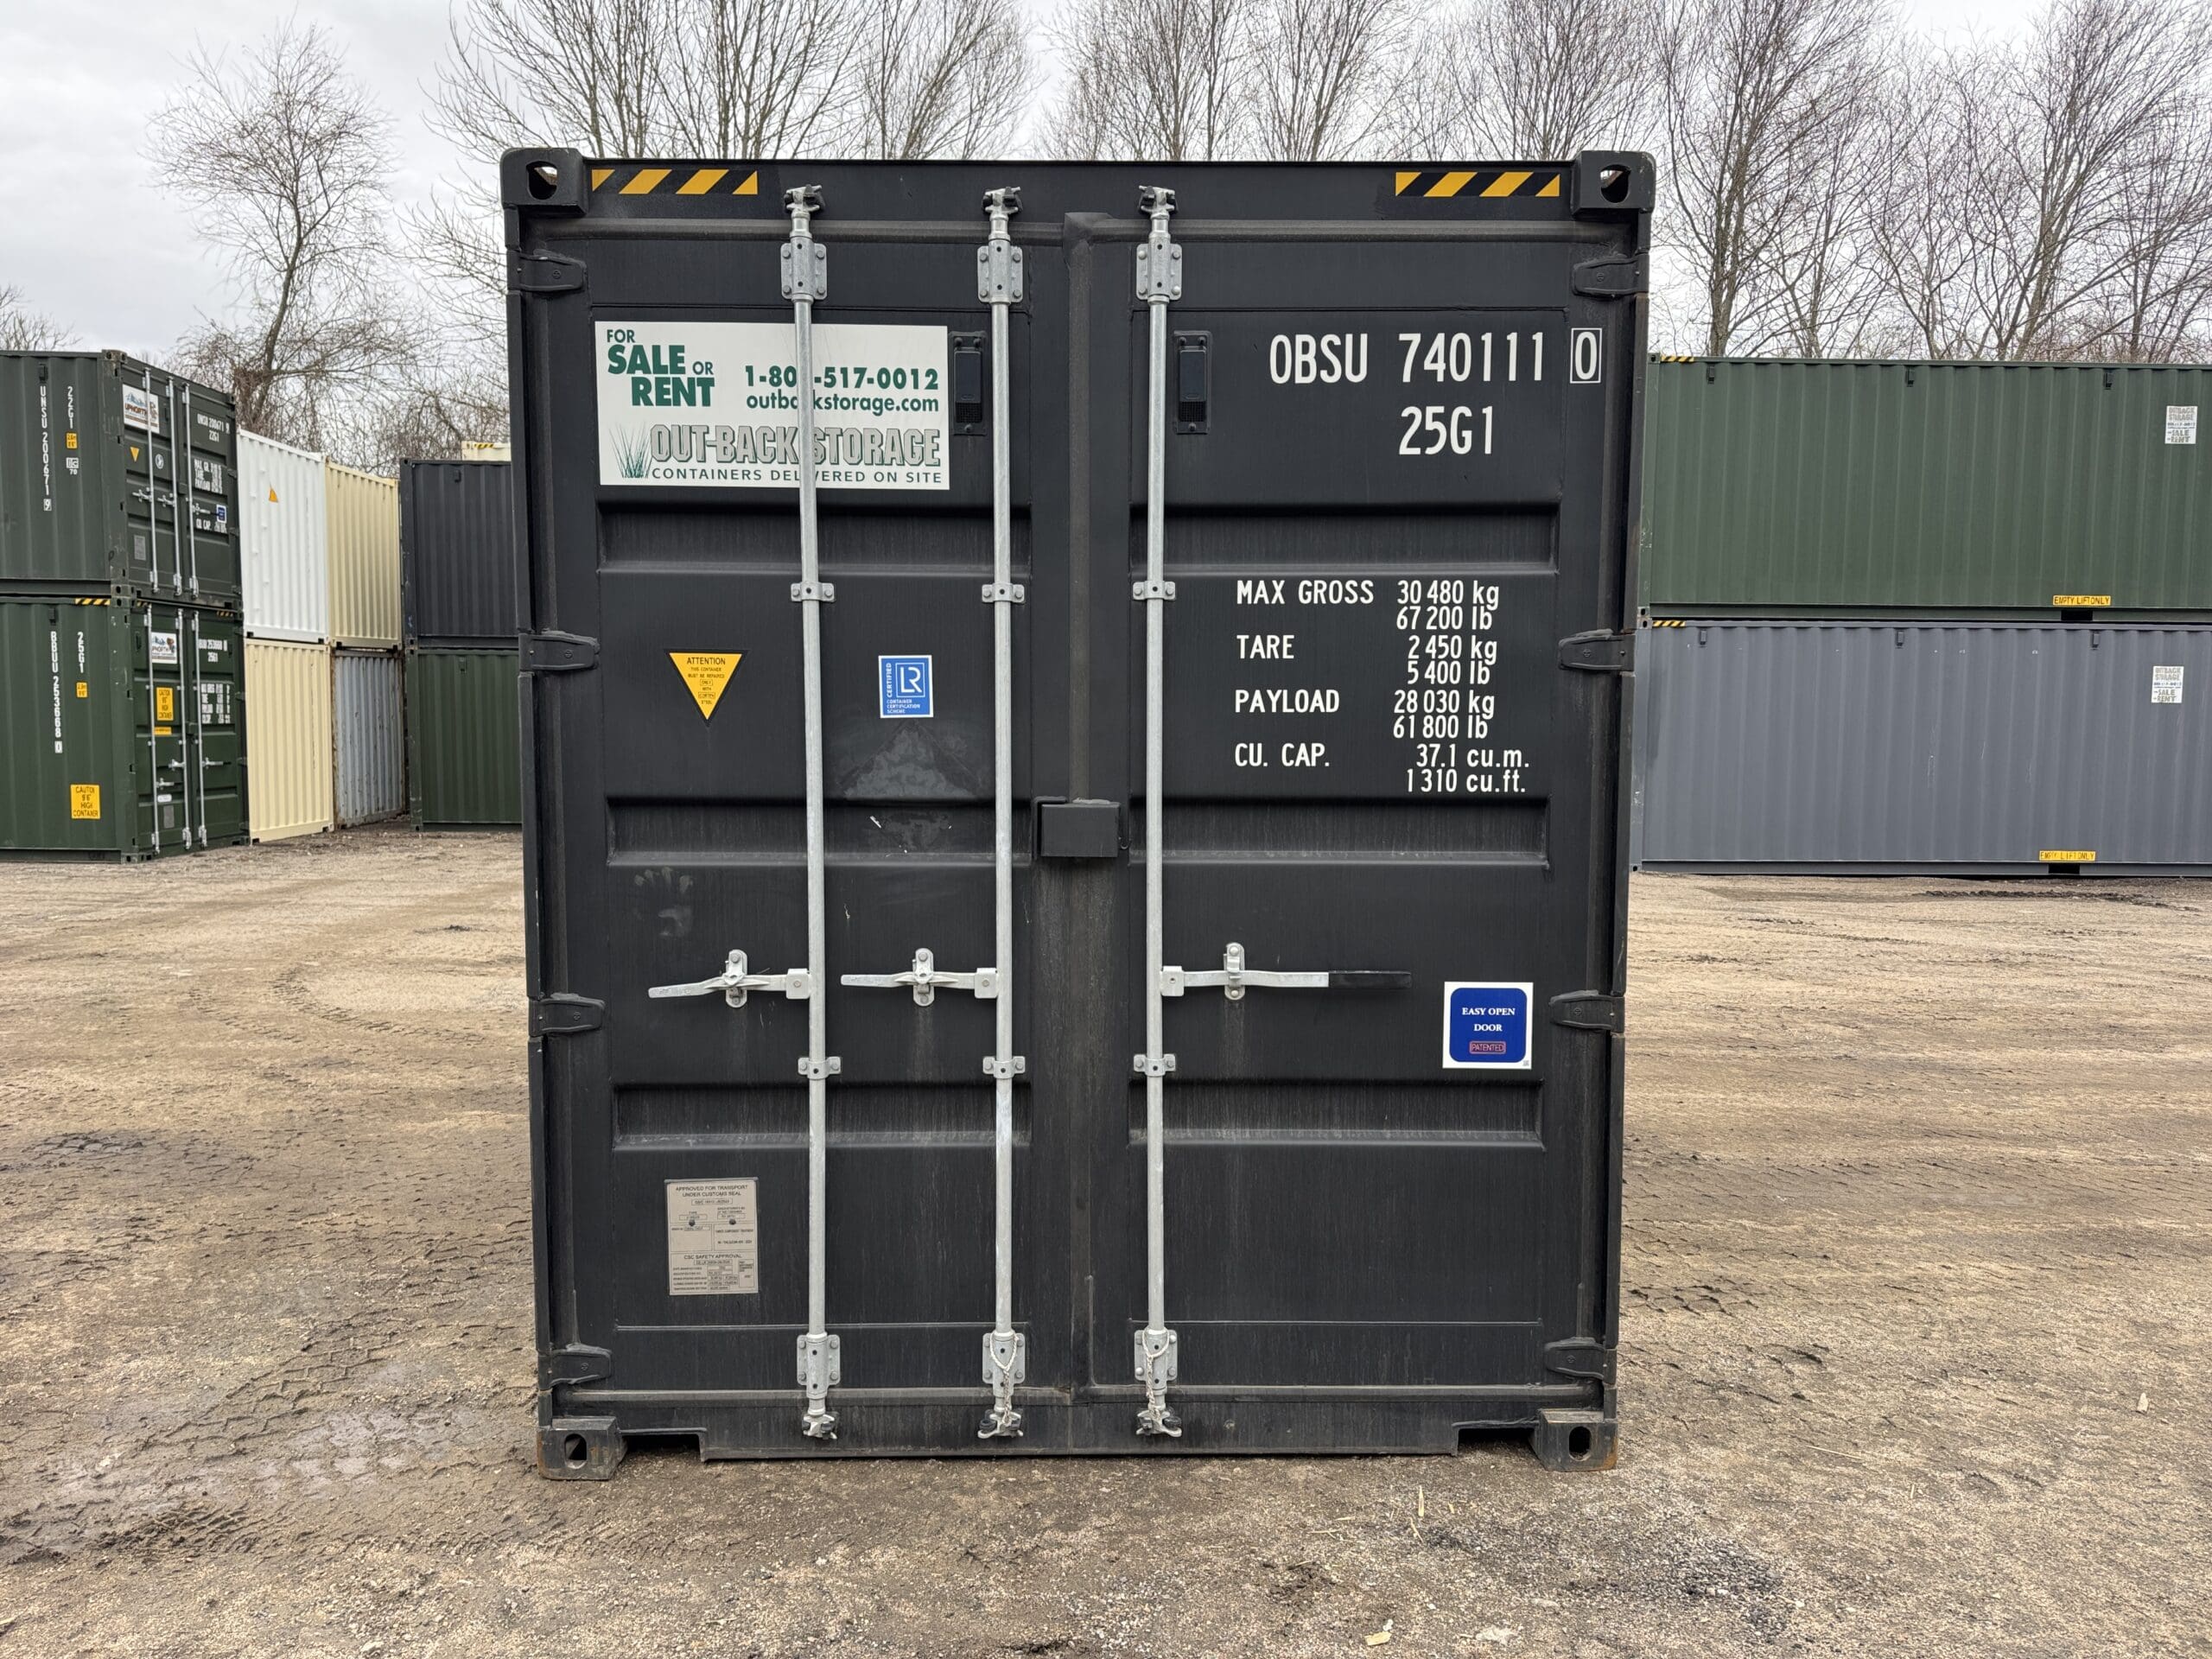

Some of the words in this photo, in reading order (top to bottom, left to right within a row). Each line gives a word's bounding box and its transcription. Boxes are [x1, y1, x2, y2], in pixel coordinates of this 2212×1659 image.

[607, 329, 635, 343] FOR
[607, 345, 685, 375] SALE
[692, 361, 714, 375] OR
[1269, 334, 1368, 384] OBSU
[1398, 332, 1544, 383] 740111
[1575, 331, 1597, 380] 0
[745, 365, 938, 391] 1-80-517-0012
[631, 377, 715, 407] RENT
[747, 389, 939, 416] outbakstorage.com
[1398, 405, 1493, 454] 25G1
[651, 424, 799, 465] OUT-BACK
[813, 427, 941, 467] STORAGE
[652, 467, 763, 481] CONTAINERS
[771, 469, 866, 483] DELERED
[874, 471, 897, 483] ON
[906, 472, 942, 484] SITE
[1236, 580, 1285, 604] MAX
[1298, 580, 1374, 604] GROSS
[1472, 580, 1499, 609] kg
[1472, 607, 1492, 630] lb
[1236, 635, 1294, 658] TARE
[1471, 635, 1497, 664] kg
[900, 666, 922, 693] LR
[1470, 661, 1490, 684] lb
[1235, 690, 1339, 713] PAYLOAD
[1469, 690, 1495, 719] kg
[1467, 715, 1488, 739] lb
[1235, 743, 1268, 766] CU.
[1281, 743, 1329, 766] CAP.
[1416, 744, 1456, 767] 37.1
[1467, 749, 1529, 767] cu.m.
[1466, 771, 1525, 792] cu.ft.
[1462, 1007, 1487, 1015] EASY
[1473, 1023, 1503, 1032] DOOR
[1471, 1043, 1504, 1052] PATENTED
